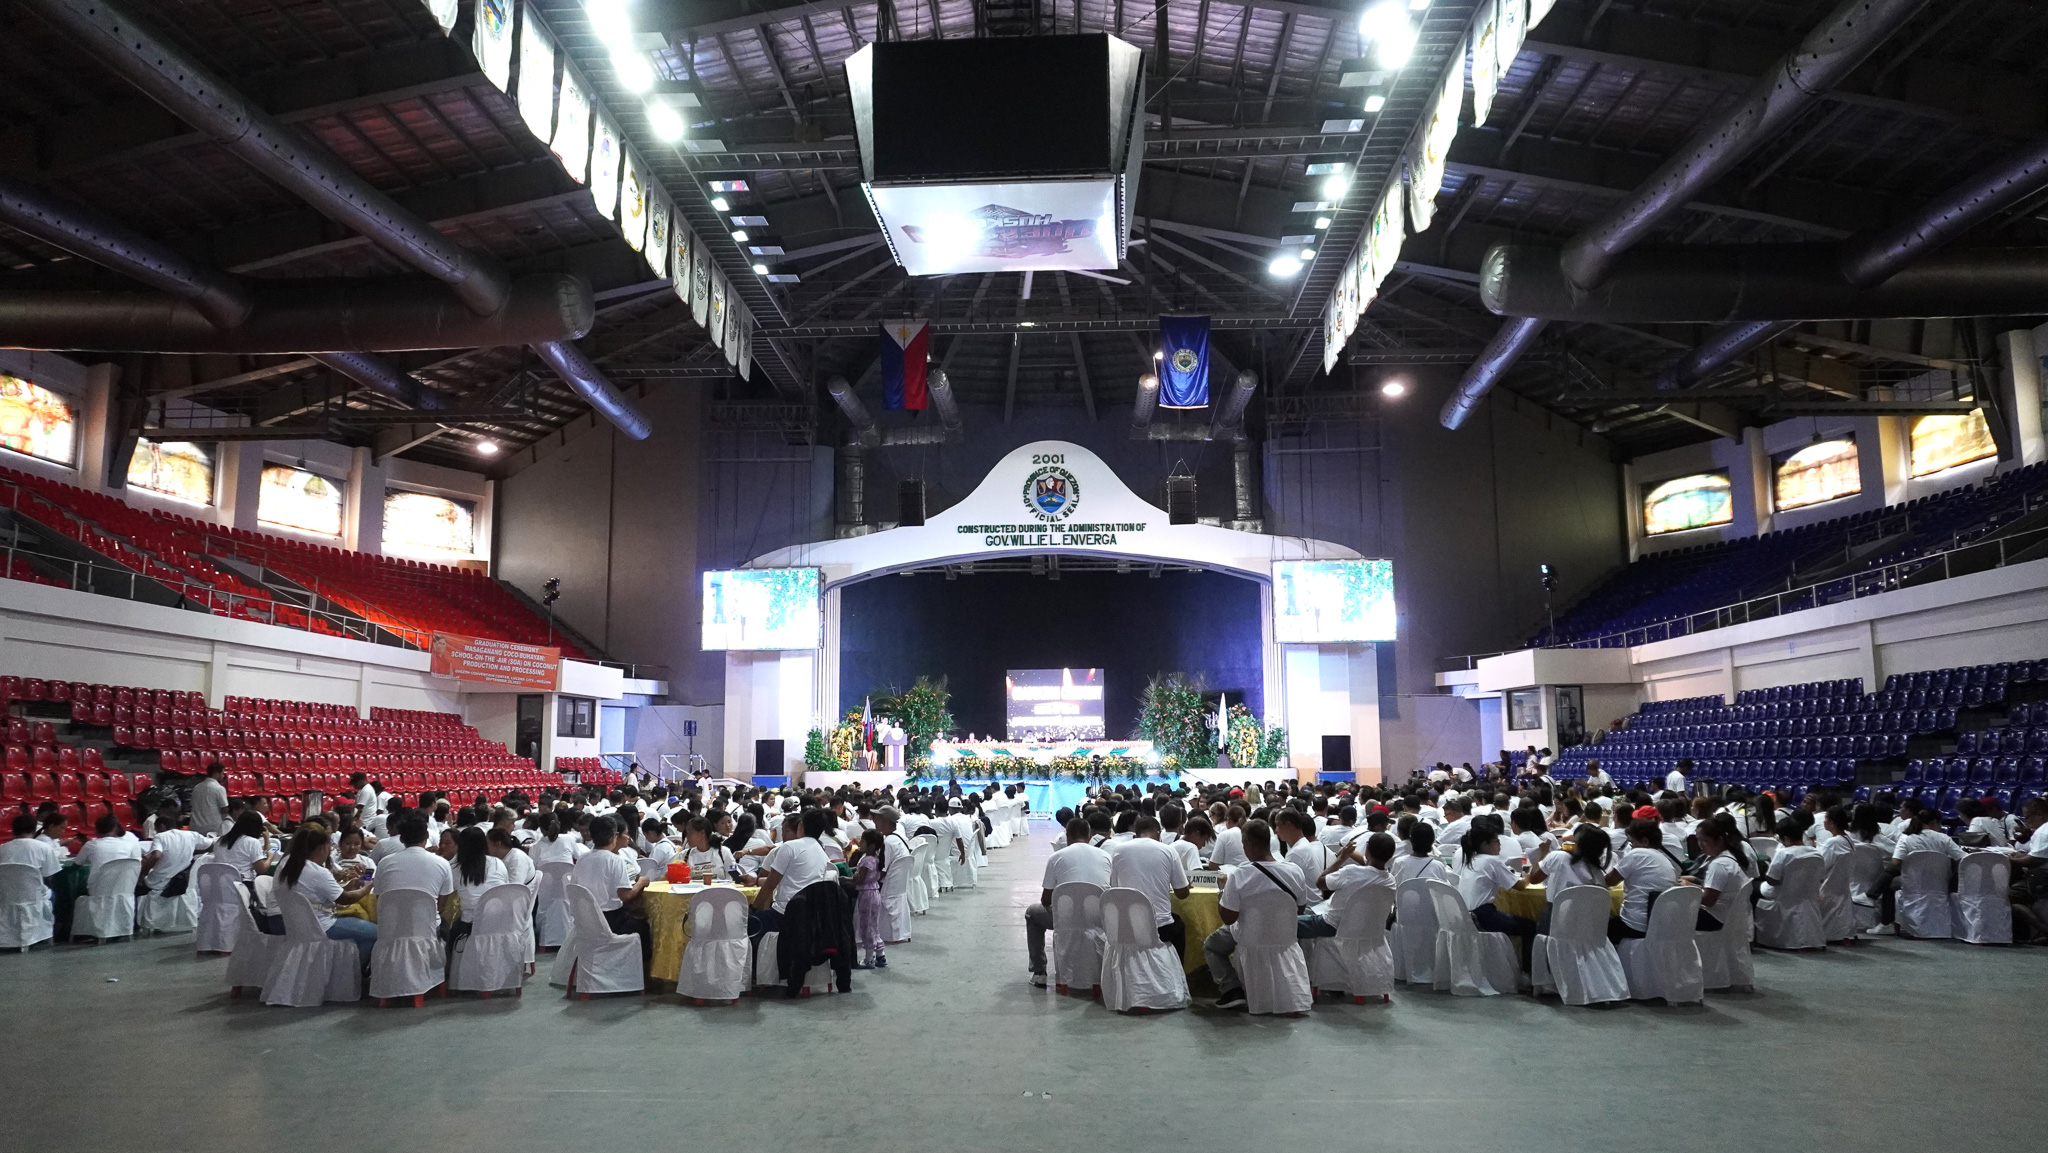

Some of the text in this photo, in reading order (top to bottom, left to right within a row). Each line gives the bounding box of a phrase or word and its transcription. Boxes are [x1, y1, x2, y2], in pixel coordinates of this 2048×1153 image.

[1032, 453, 1065, 465] 2001
[1049, 465, 1061, 474] OF
[1058, 468, 1080, 495] QUEZON
[1023, 496, 1080, 523] OFFICIAL SEAL
[957, 522, 1147, 534] CONSTRUCTED DURING THE ADMINISTRATION OF
[1049, 534, 1061, 546] L.
[1062, 533, 1118, 546] ENVERGA
[474, 639, 539, 653] GRADUATION CEREMONY
[451, 650, 495, 662] SCHOOL-ON-THE
[532, 661, 558, 670] COCONUT
[462, 659, 499, 670] PRODUCTION
[511, 666, 545, 676] PROCESSING
[1192, 875, 1217, 884] ANTONIO
